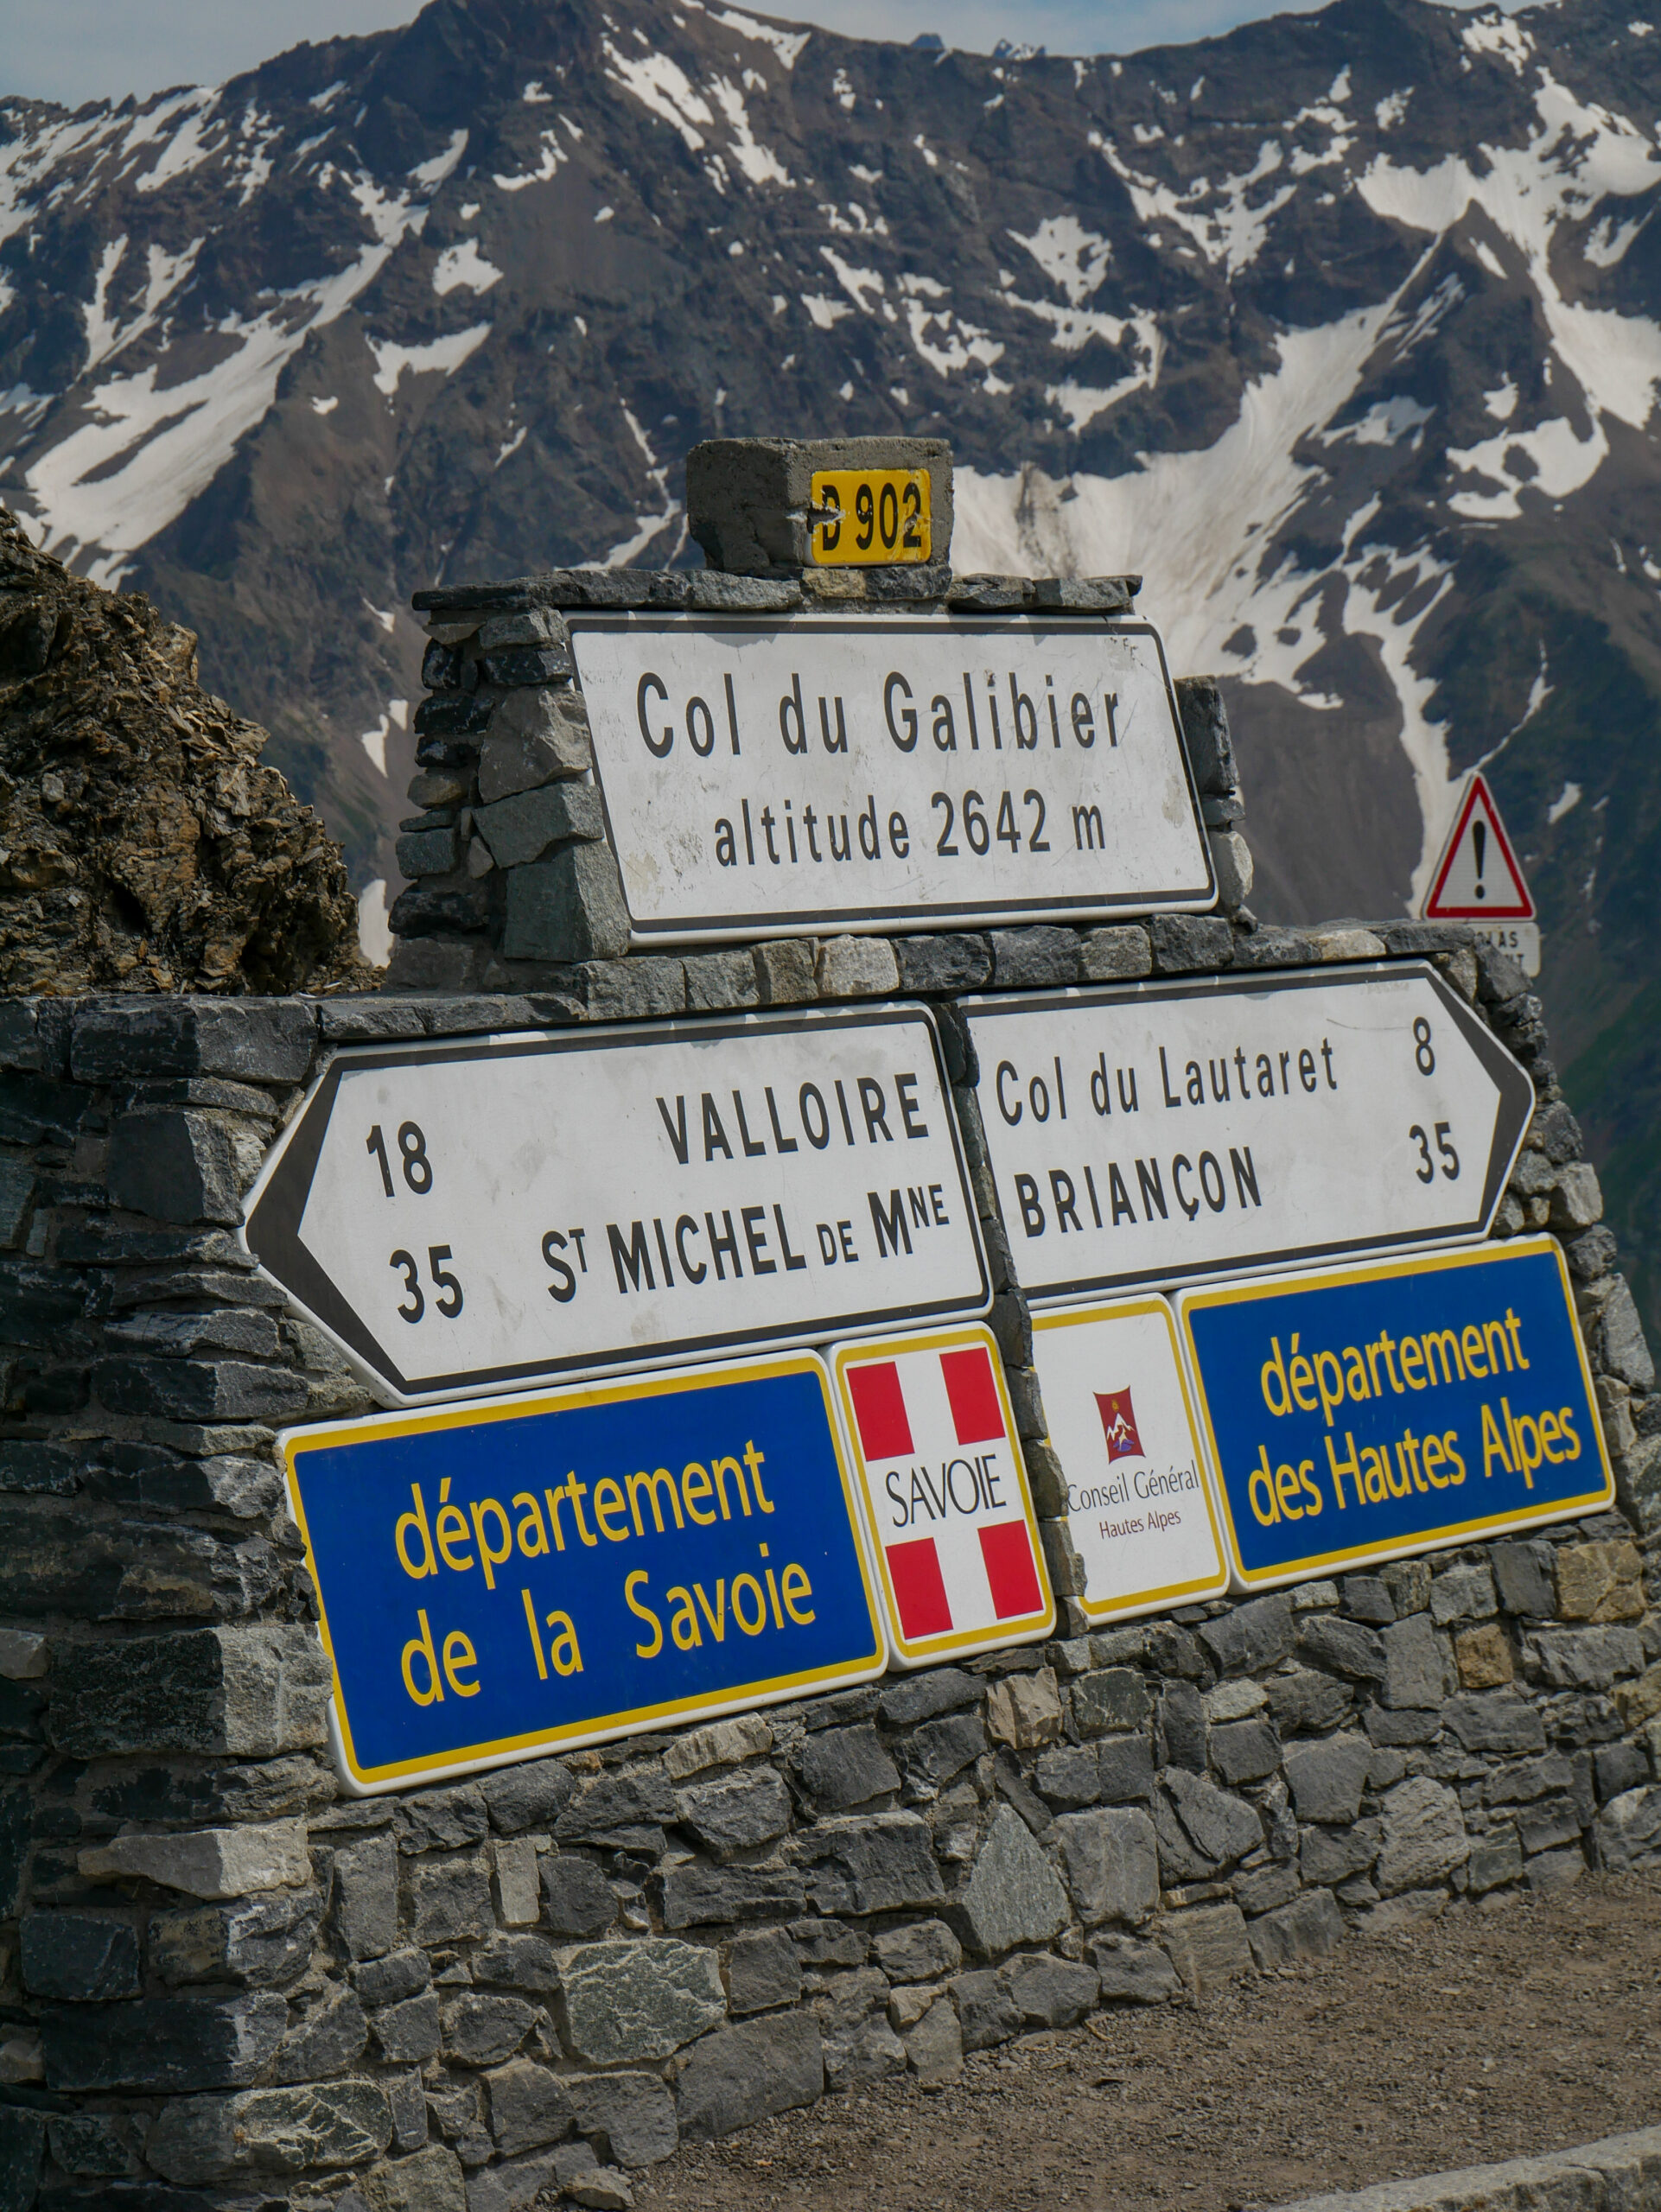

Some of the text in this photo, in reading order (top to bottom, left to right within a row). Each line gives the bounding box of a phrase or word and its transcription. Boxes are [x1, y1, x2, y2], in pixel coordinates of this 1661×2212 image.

[822, 482, 922, 550] D 902
[637, 671, 1118, 758] Col du Galibier
[715, 789, 1105, 867] altitude 2642 m
[996, 1038, 1337, 1126] Col du Lautaret
[1413, 1017, 1435, 1076] 8
[366, 1122, 432, 1198] 18
[656, 1073, 929, 1165] VALLOIRE
[1410, 1122, 1460, 1184] 35
[1014, 1147, 1262, 1237] BRIANÇON
[390, 1245, 463, 1324] 35
[606, 1204, 806, 1294] MICHEL
[816, 1221, 859, 1266] DE
[1261, 1308, 1530, 1427] département
[886, 1454, 1007, 1527] SAVOIE
[1068, 1460, 1199, 1511] Conseil Général
[1249, 1397, 1581, 1526] des Hautes Alpes
[396, 1440, 774, 1589] département
[1099, 1511, 1181, 1539] Hautes Alpes
[401, 1542, 815, 1706] de la Savoie
